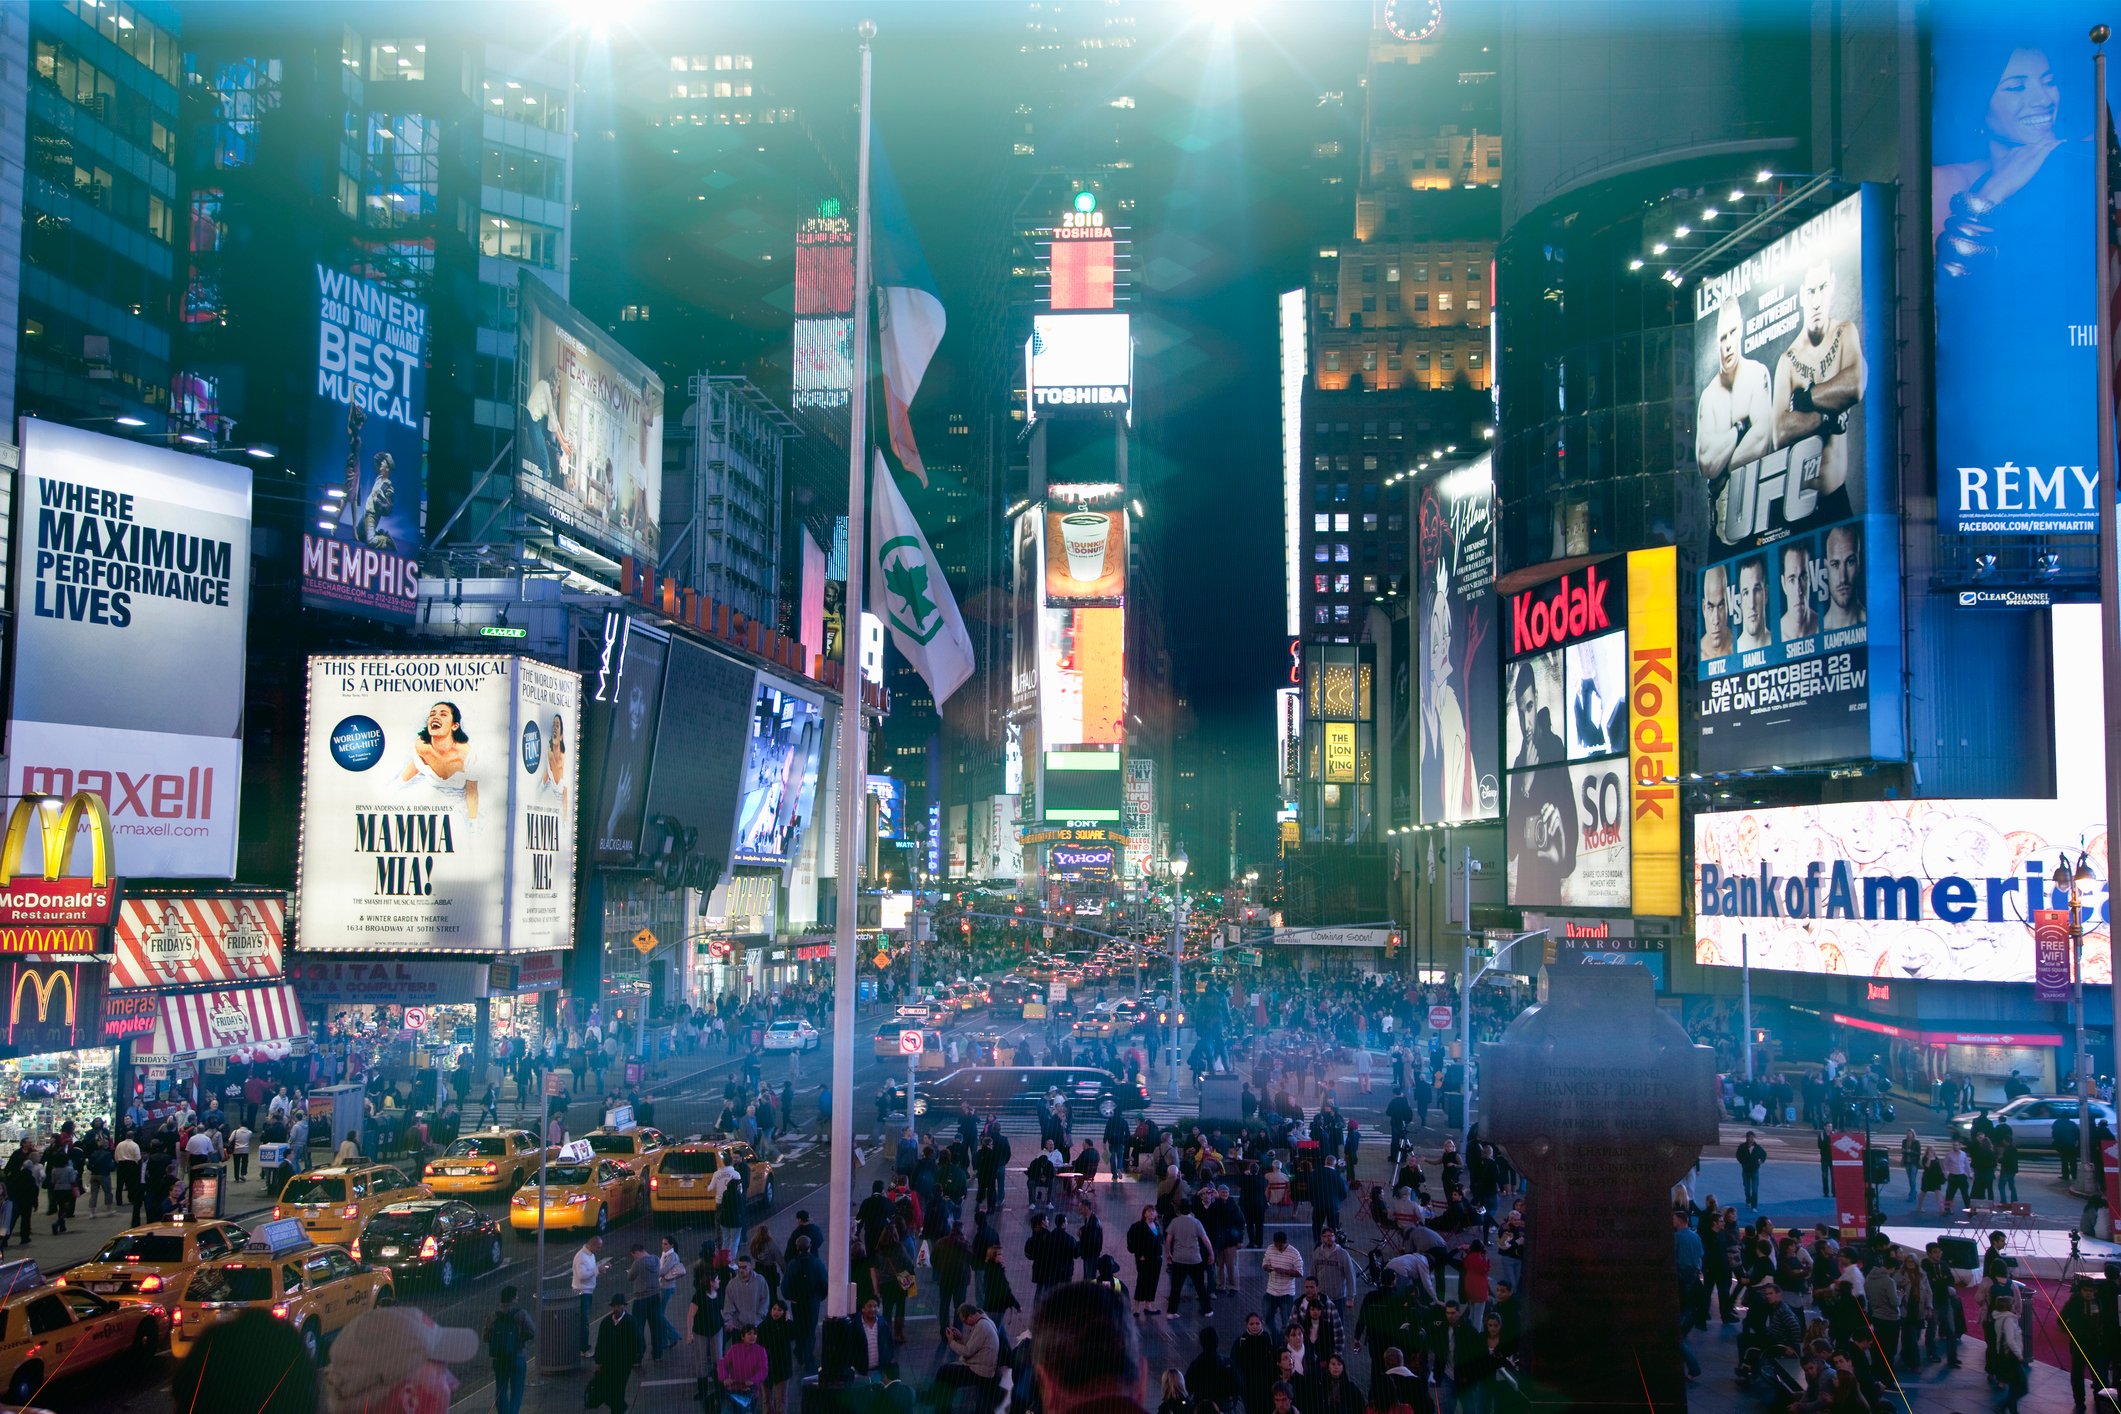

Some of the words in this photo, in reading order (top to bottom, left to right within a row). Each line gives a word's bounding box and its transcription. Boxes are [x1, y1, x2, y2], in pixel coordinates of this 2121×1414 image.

[1063, 212, 1104, 228] 2010
[1053, 227, 1113, 239] TOSHIBA
[317, 263, 424, 335] WINNER!
[1696, 259, 1751, 320] LESNAR
[1758, 284, 1785, 312] WORLD
[321, 297, 350, 327] 2010
[354, 310, 382, 340] TONY
[385, 323, 419, 354] AWARD
[1746, 294, 1798, 336] HEAVYWEIGHT
[1744, 311, 1800, 354] CHAMPIONSHIP
[319, 320, 419, 399] BEST
[557, 341, 577, 380] LIFE
[598, 371, 631, 415] KNOW
[632, 397, 640, 425] IT
[318, 369, 417, 428] MUSICAL
[1033, 387, 1128, 405] TOSHIBA
[1803, 455, 1822, 482] 121
[1724, 434, 1824, 542] UFC
[1956, 461, 2100, 511] RÉMY
[38, 477, 134, 522] WHERE
[549, 505, 570, 524] OCTOBER
[1958, 520, 2094, 532] FACEBOOK.COM/REMYMARTIN
[37, 507, 232, 580] MAXIMUM
[302, 533, 419, 600] MEMPHIS
[36, 550, 229, 607] PERFORMANCE
[305, 577, 367, 598] TELECHARGE.COM
[1808, 557, 1829, 602] VS
[35, 580, 132, 628] LIVES
[1513, 564, 1610, 655] Kodak
[1727, 585, 1743, 625] VS
[484, 628, 521, 637] LAMAR
[1823, 626, 1868, 651] KAMPMANN
[1786, 638, 1815, 659] SHIELDS
[361, 662, 440, 677] FEEL-GOOD
[445, 660, 508, 677] MUSICAL
[1708, 658, 1727, 676] ORTIZ
[1743, 650, 1767, 669] HAMILL
[342, 677, 355, 692] IS
[359, 678, 370, 692] A
[534, 671, 558, 691] WORLD'S
[558, 679, 573, 694] MOST
[1711, 676, 1742, 698] SAT.
[1746, 659, 1823, 692] OCTOBER
[1828, 653, 1852, 675] 23
[522, 683, 548, 703] POPULAR
[1701, 699, 1731, 717] LIVE
[1734, 694, 1756, 711] ON
[1759, 669, 1868, 706] PAY-PER-VIEW
[333, 729, 381, 745] WORLDWIDE
[1332, 733, 1349, 743] THE
[1633, 647, 1675, 822] Kodak
[1328, 744, 1352, 758] LION
[1328, 760, 1353, 775] KING
[22, 766, 214, 820] maxell
[1582, 771, 1623, 838] SO
[354, 813, 455, 854] MAMMA
[526, 812, 559, 852] MAMMA
[1066, 820, 1099, 828] SONY
[1584, 819, 1622, 850] Kodak
[599, 837, 633, 852] BLACKGLAMA
[1054, 852, 1112, 865] YAHOO!
[374, 855, 434, 896] MIA!
[532, 853, 553, 890] MIA!
[725, 876, 773, 917] FOREVER
[1701, 862, 1785, 917] Bank
[0, 892, 107, 909] McDonald's
[364, 898, 383, 906] SMASH
[11, 910, 87, 920] Restaurant
[366, 915, 391, 923] WINTER
[393, 915, 419, 923] GARDEN
[421, 915, 449, 923] THEATRE
[346, 924, 363, 932] 1634
[365, 924, 404, 933] BROADWAY
[406, 925, 414, 933] AT
[416, 925, 434, 933] 50TH
[1310, 929, 1344, 943] Coming
[1346, 931, 1374, 943] soon!
[1566, 922, 1609, 939] Marriott
[151, 936, 192, 953] FRIDAY'S
[227, 933, 263, 950] FRIDAY'S
[1565, 939, 1665, 950] MARQUIS
[2040, 941, 2065, 951] FREE
[216, 1013, 244, 1028] FRIDAY'S
[135, 1055, 169, 1064] FRIDAY'S
[150, 1069, 166, 1079] ATM
[1535, 1081, 1598, 1097] FRANCIS
[1620, 1082, 1673, 1097] DUFFY
